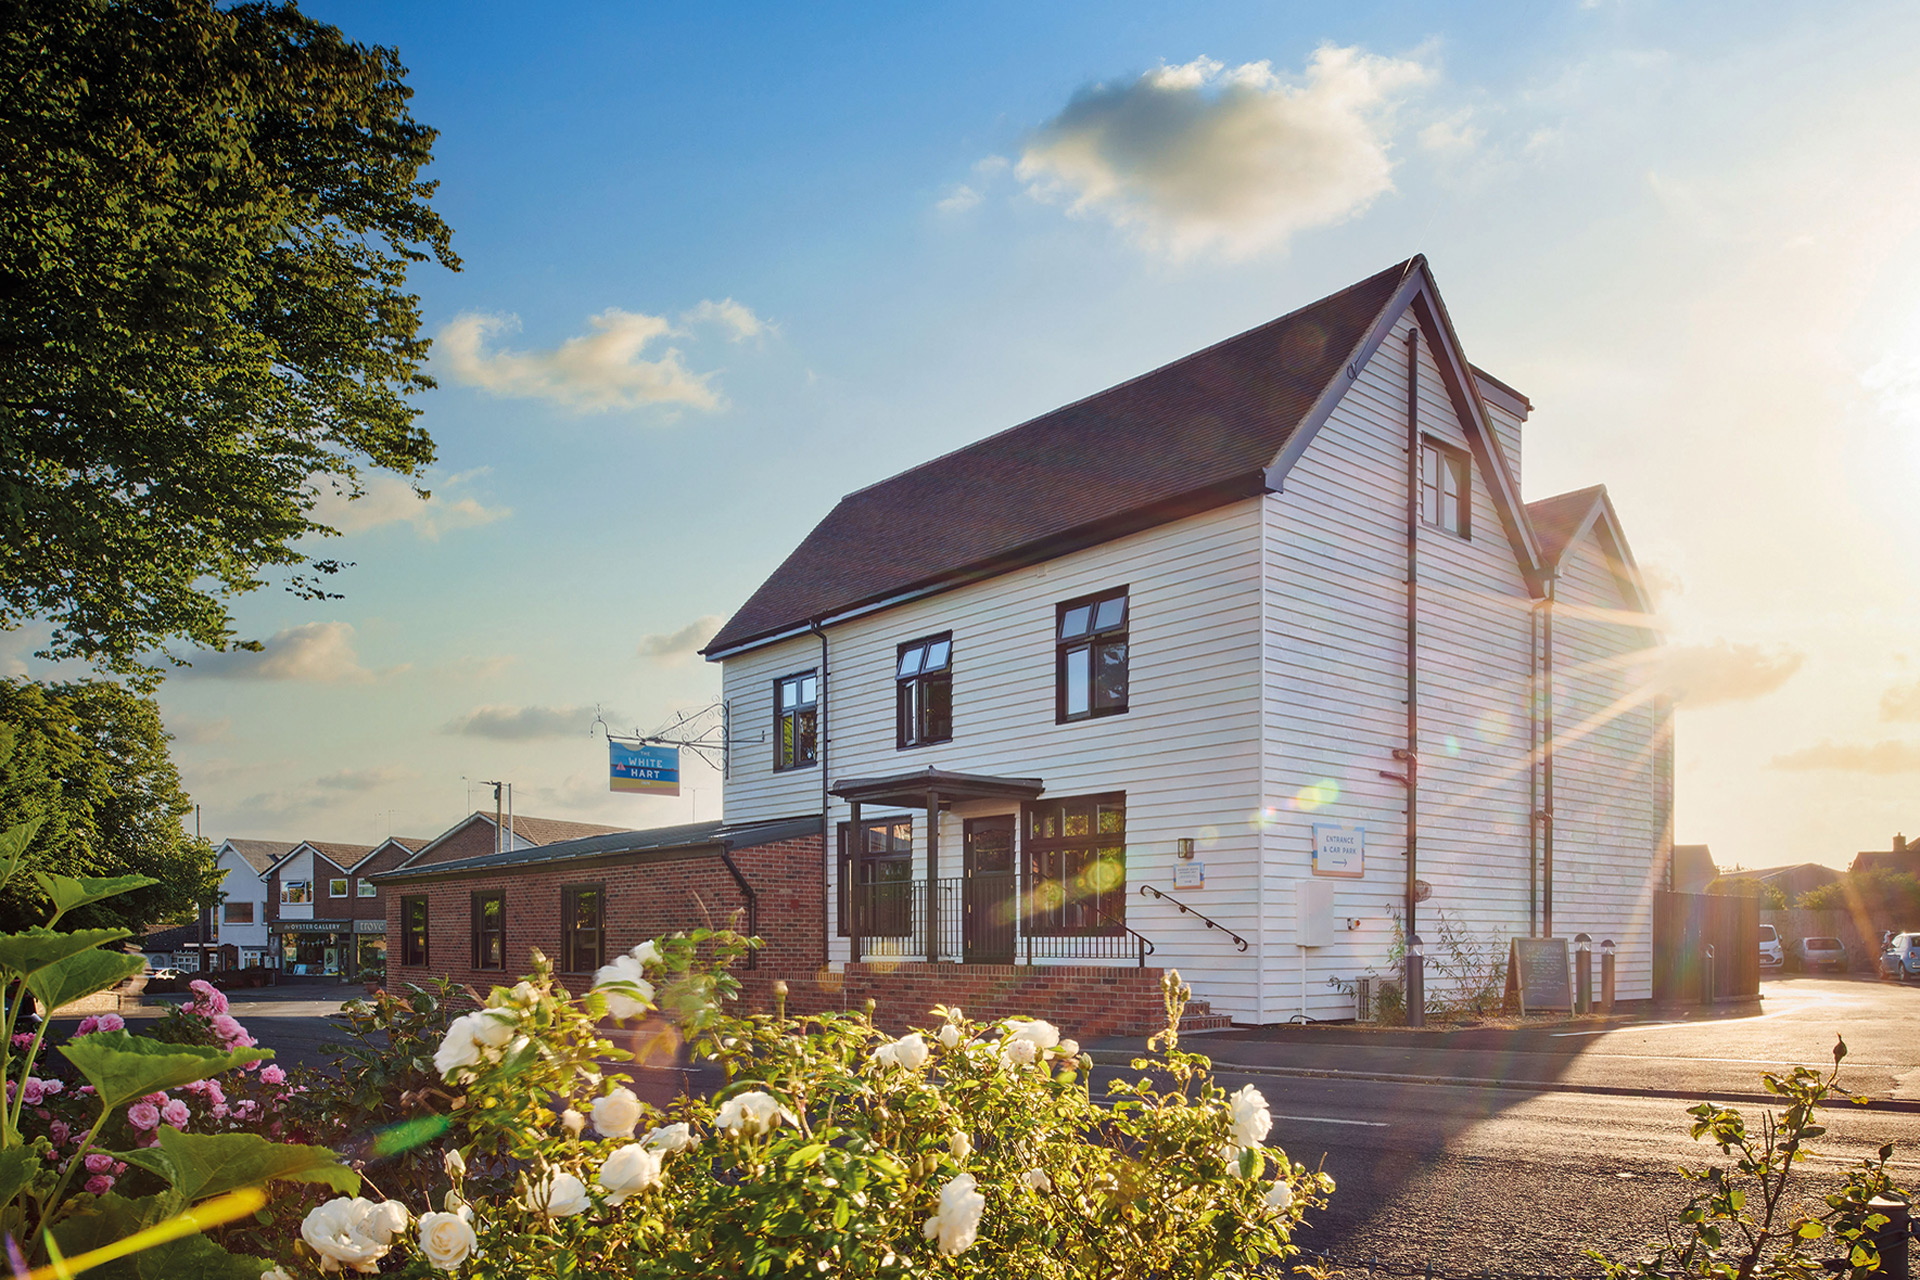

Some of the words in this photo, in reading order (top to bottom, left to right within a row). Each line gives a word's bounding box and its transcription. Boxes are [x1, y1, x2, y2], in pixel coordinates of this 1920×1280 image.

[628, 757, 663, 768] WHITE
[631, 769, 660, 779] HART
[1326, 835, 1354, 844] ENTRANCE
[360, 922, 384, 931] trove
